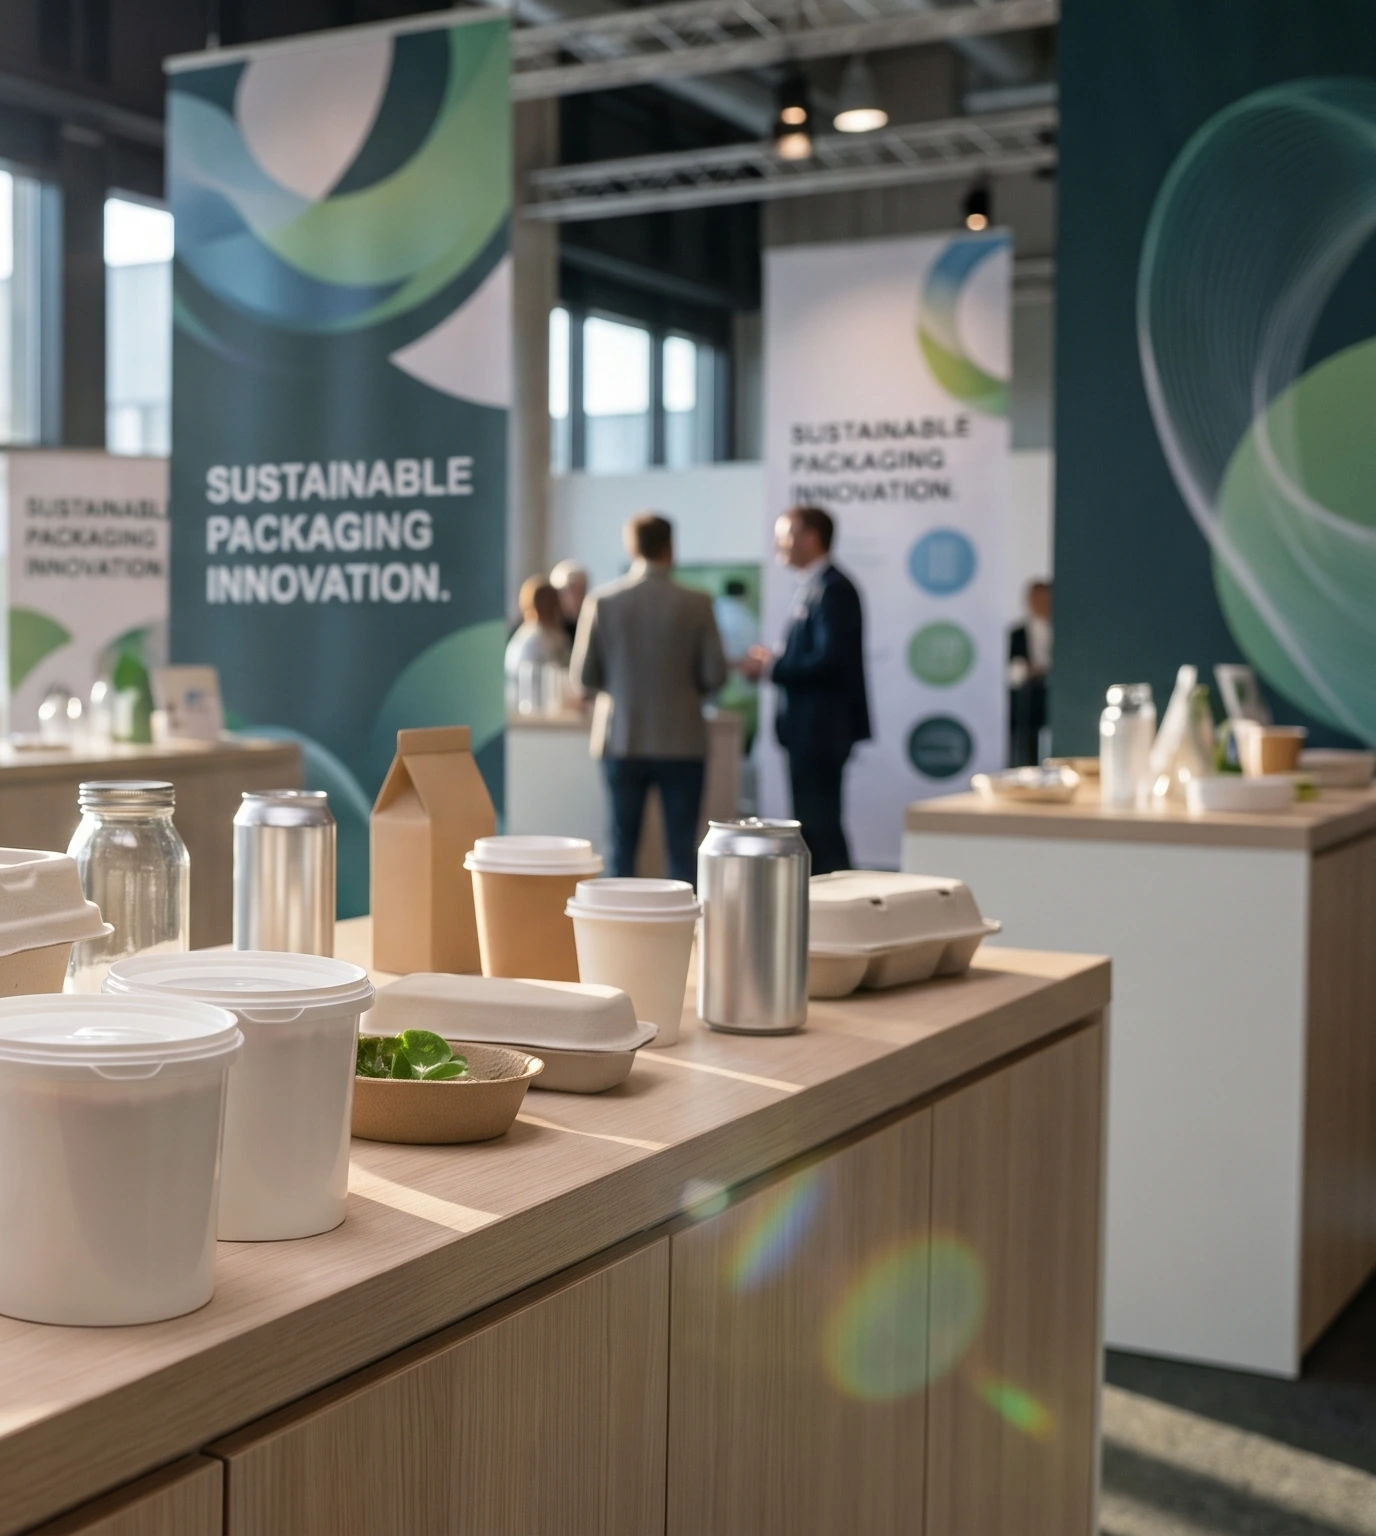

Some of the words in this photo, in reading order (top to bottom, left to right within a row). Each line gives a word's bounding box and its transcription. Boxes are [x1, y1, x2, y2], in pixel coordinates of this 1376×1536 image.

[791, 416, 970, 446] SUSTAINABLE
[791, 449, 945, 475] PACKAGING
[205, 456, 473, 504] SUSTAINABLE
[26, 496, 171, 520] SUSTAINABL
[26, 525, 156, 548] PACKAGING
[206, 509, 433, 554] PACKAGING
[206, 562, 451, 604] INNOVATION.
